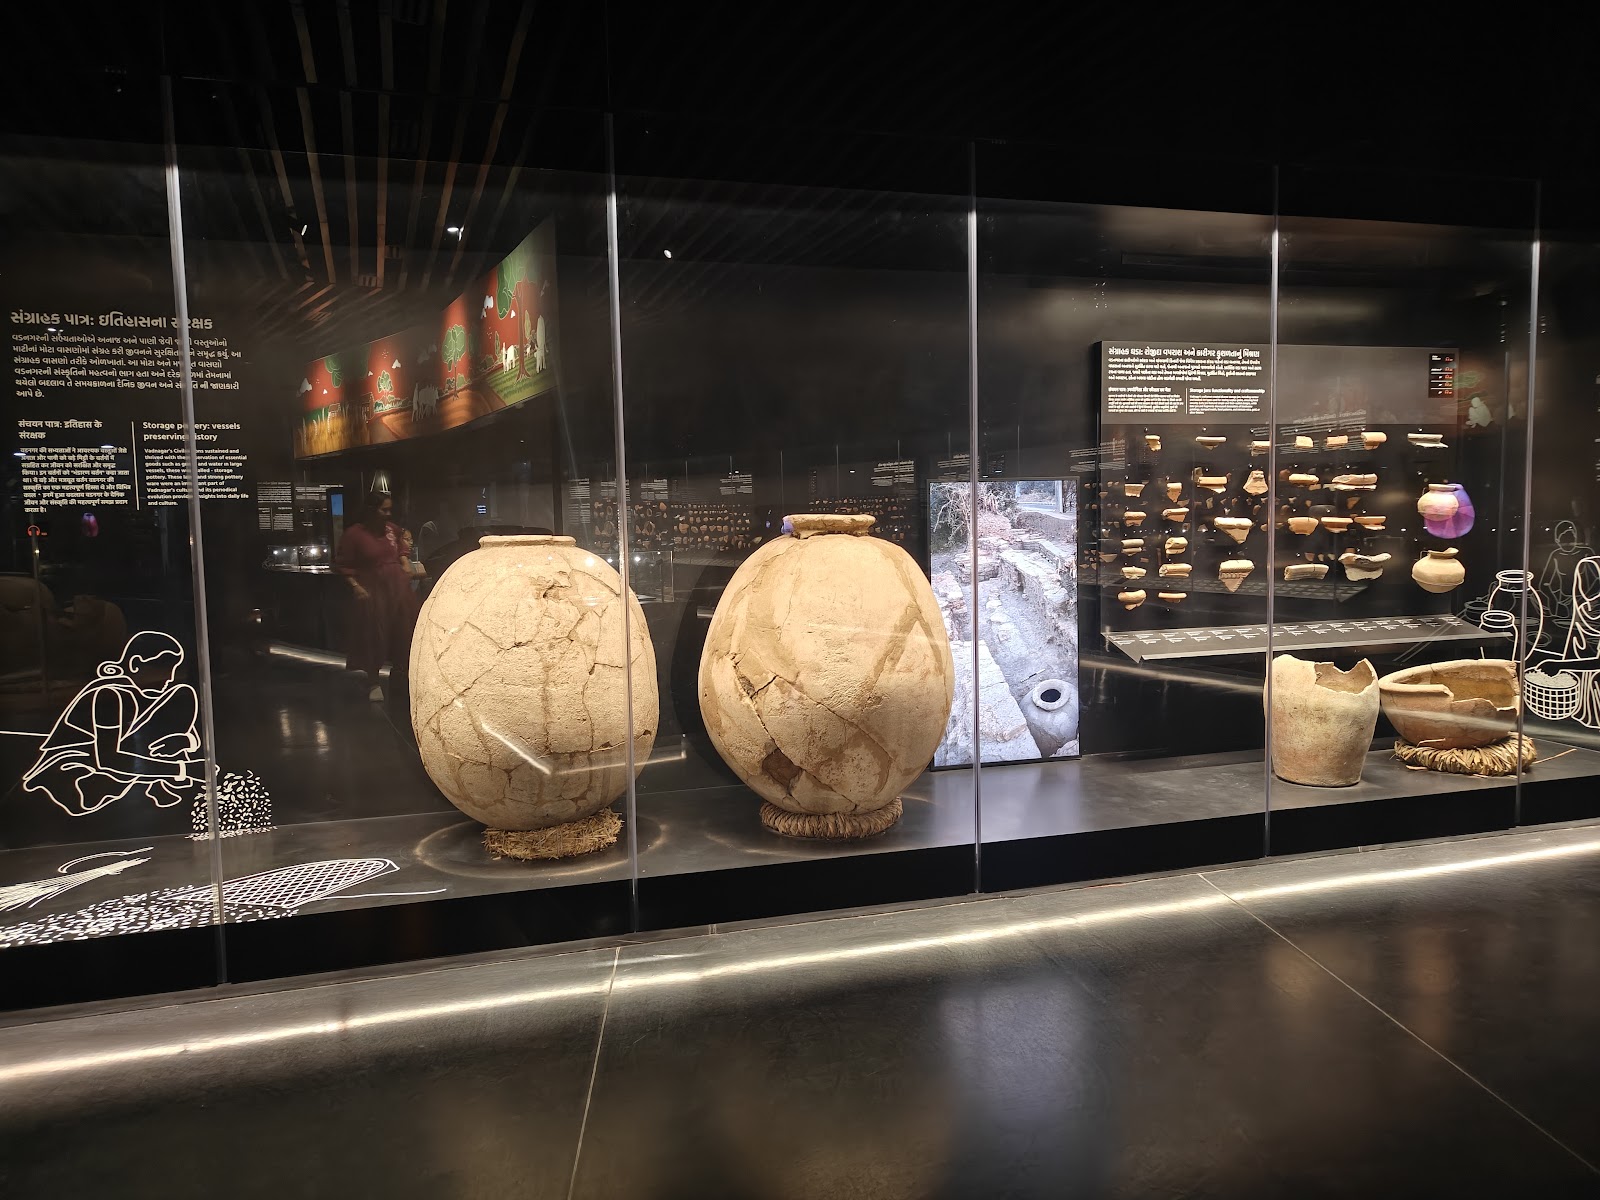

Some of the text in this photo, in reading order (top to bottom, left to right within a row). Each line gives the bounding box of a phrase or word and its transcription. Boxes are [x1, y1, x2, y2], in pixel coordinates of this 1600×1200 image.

[11, 309, 60, 324] સંગ્રાહક
[64, 314, 94, 325] પાત્ર:
[99, 311, 166, 328] ઇતિહાસના
[123, 335, 137, 344] અને
[140, 336, 156, 345] પાણી
[158, 336, 172, 345] જેવી
[40, 344, 54, 353] મોટા
[112, 346, 123, 355] કરી
[42, 356, 68, 364] વાસણો
[140, 358, 154, 366] મોટા
[157, 358, 170, 367] અને
[198, 359, 222, 368] વાસણો
[151, 369, 165, 378] અને
[159, 380, 173, 388] અને
[16, 388, 32, 397] આપે
[94, 420, 102, 428] के
[143, 422, 174, 430] Storage
